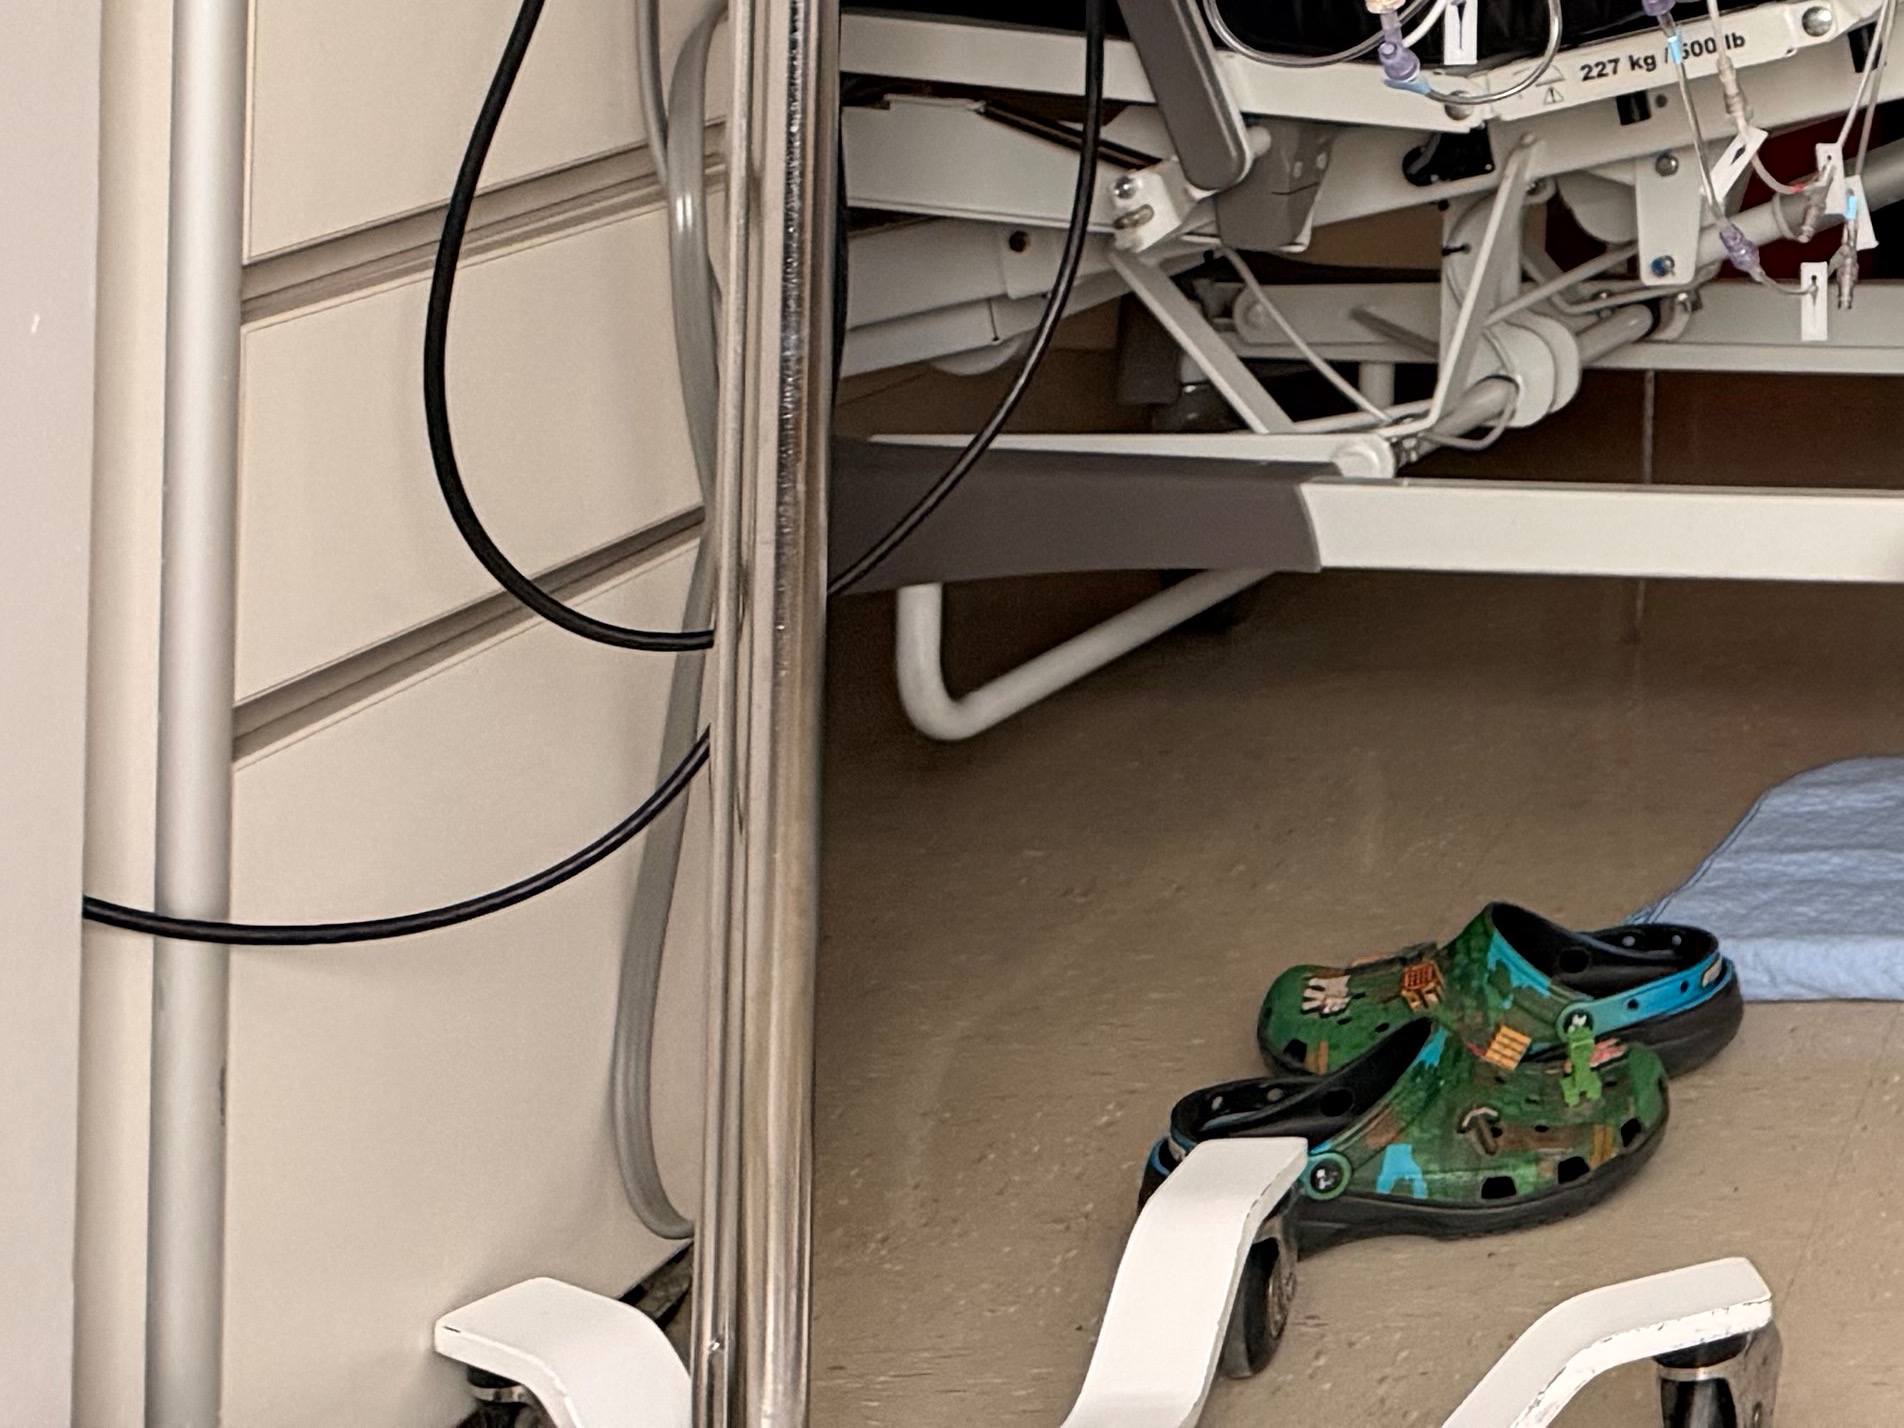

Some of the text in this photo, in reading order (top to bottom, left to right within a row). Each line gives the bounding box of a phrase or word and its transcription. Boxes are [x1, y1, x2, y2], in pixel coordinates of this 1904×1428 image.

[1580, 58, 1621, 82] 227
[1630, 53, 1657, 73] kg
[1725, 32, 1746, 50] lb
